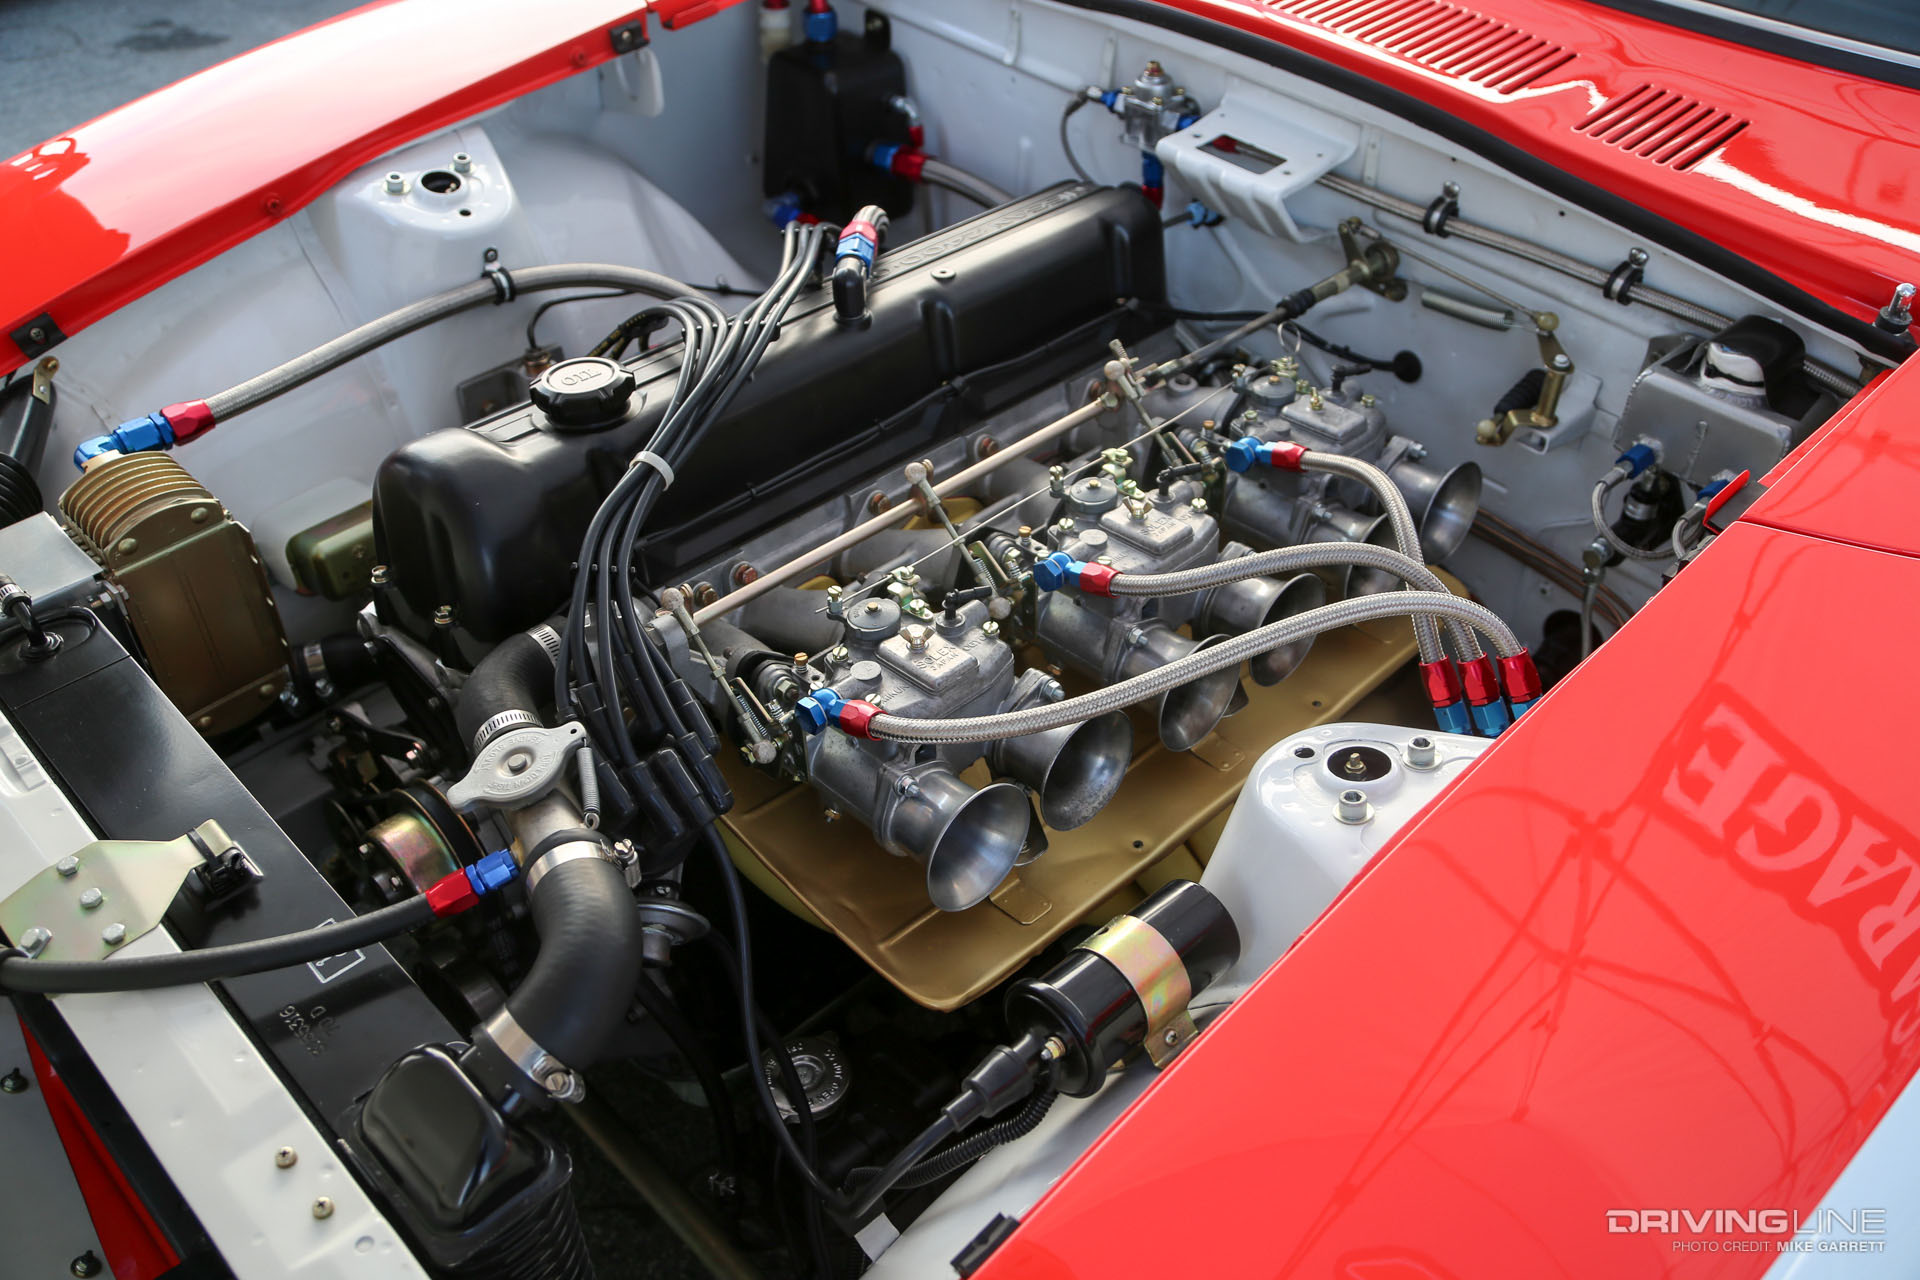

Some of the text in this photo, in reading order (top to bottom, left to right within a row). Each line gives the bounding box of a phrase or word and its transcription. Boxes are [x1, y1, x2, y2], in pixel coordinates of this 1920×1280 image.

[561, 369, 602, 386] OIL
[913, 645, 956, 670] SOLEX
[932, 654, 959, 671] JAPAN
